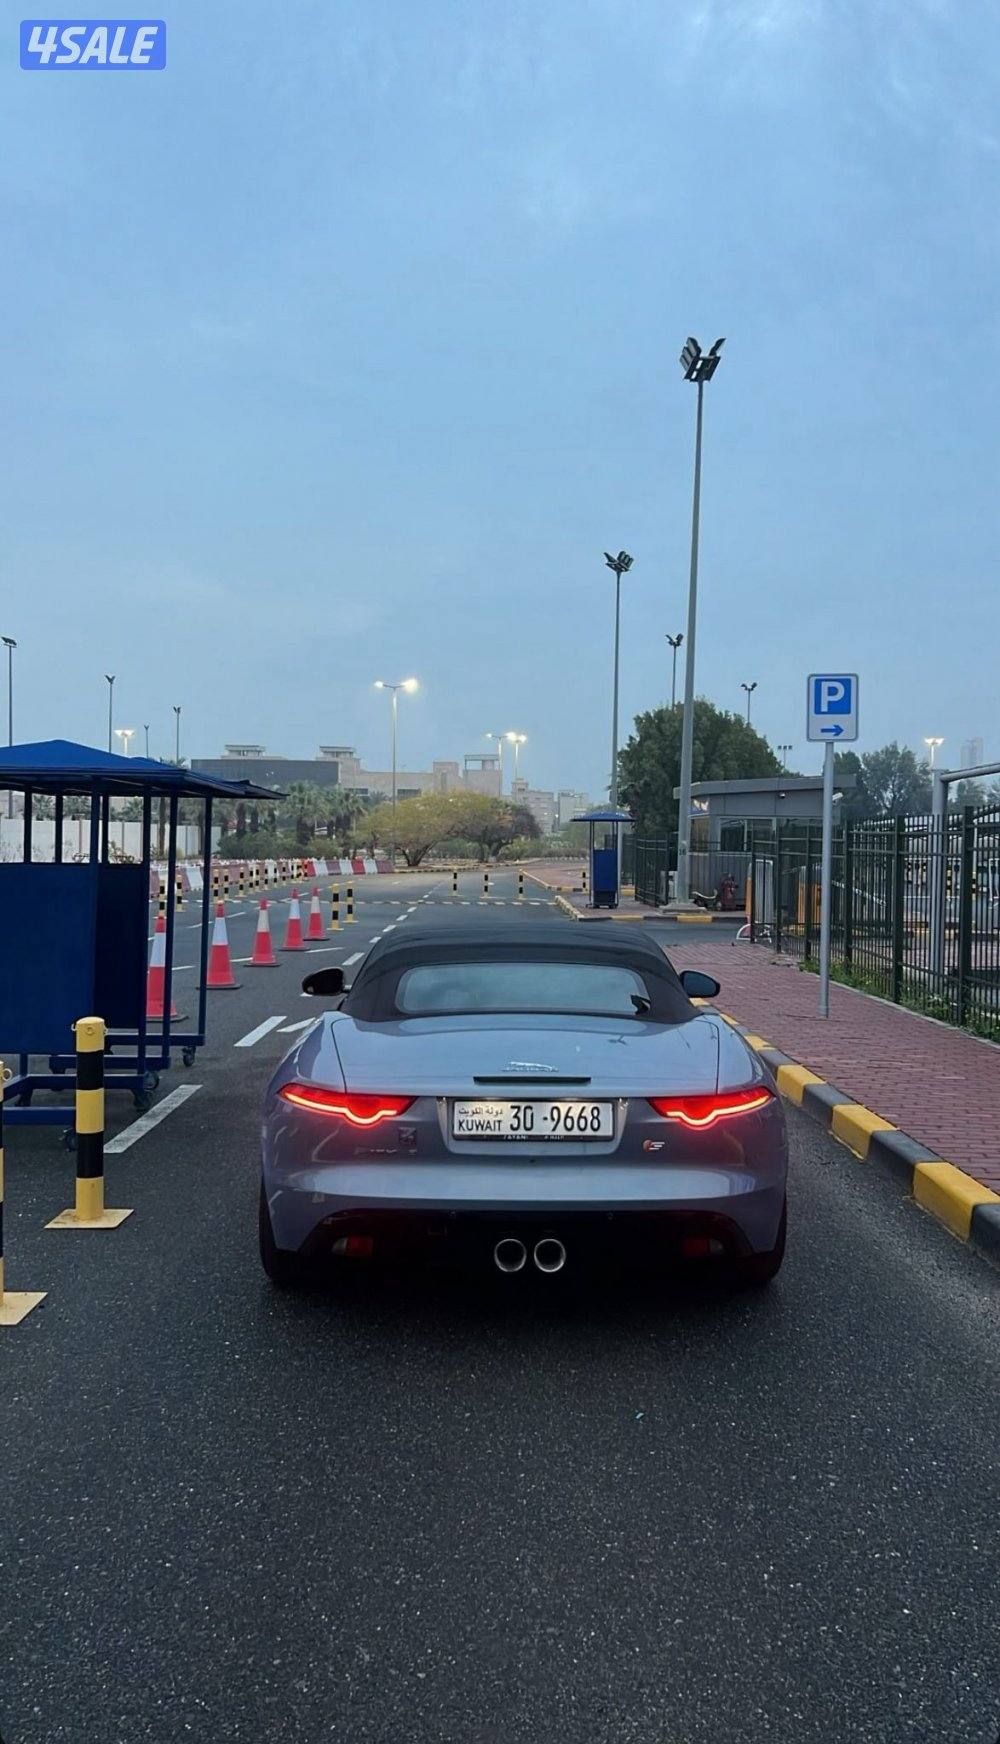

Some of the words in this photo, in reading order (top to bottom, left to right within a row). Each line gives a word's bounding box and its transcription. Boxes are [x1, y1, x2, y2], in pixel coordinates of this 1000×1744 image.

[820, 681, 845, 712] P
[458, 1119, 502, 1131] KUWAIT
[509, 1105, 534, 1131] 30
